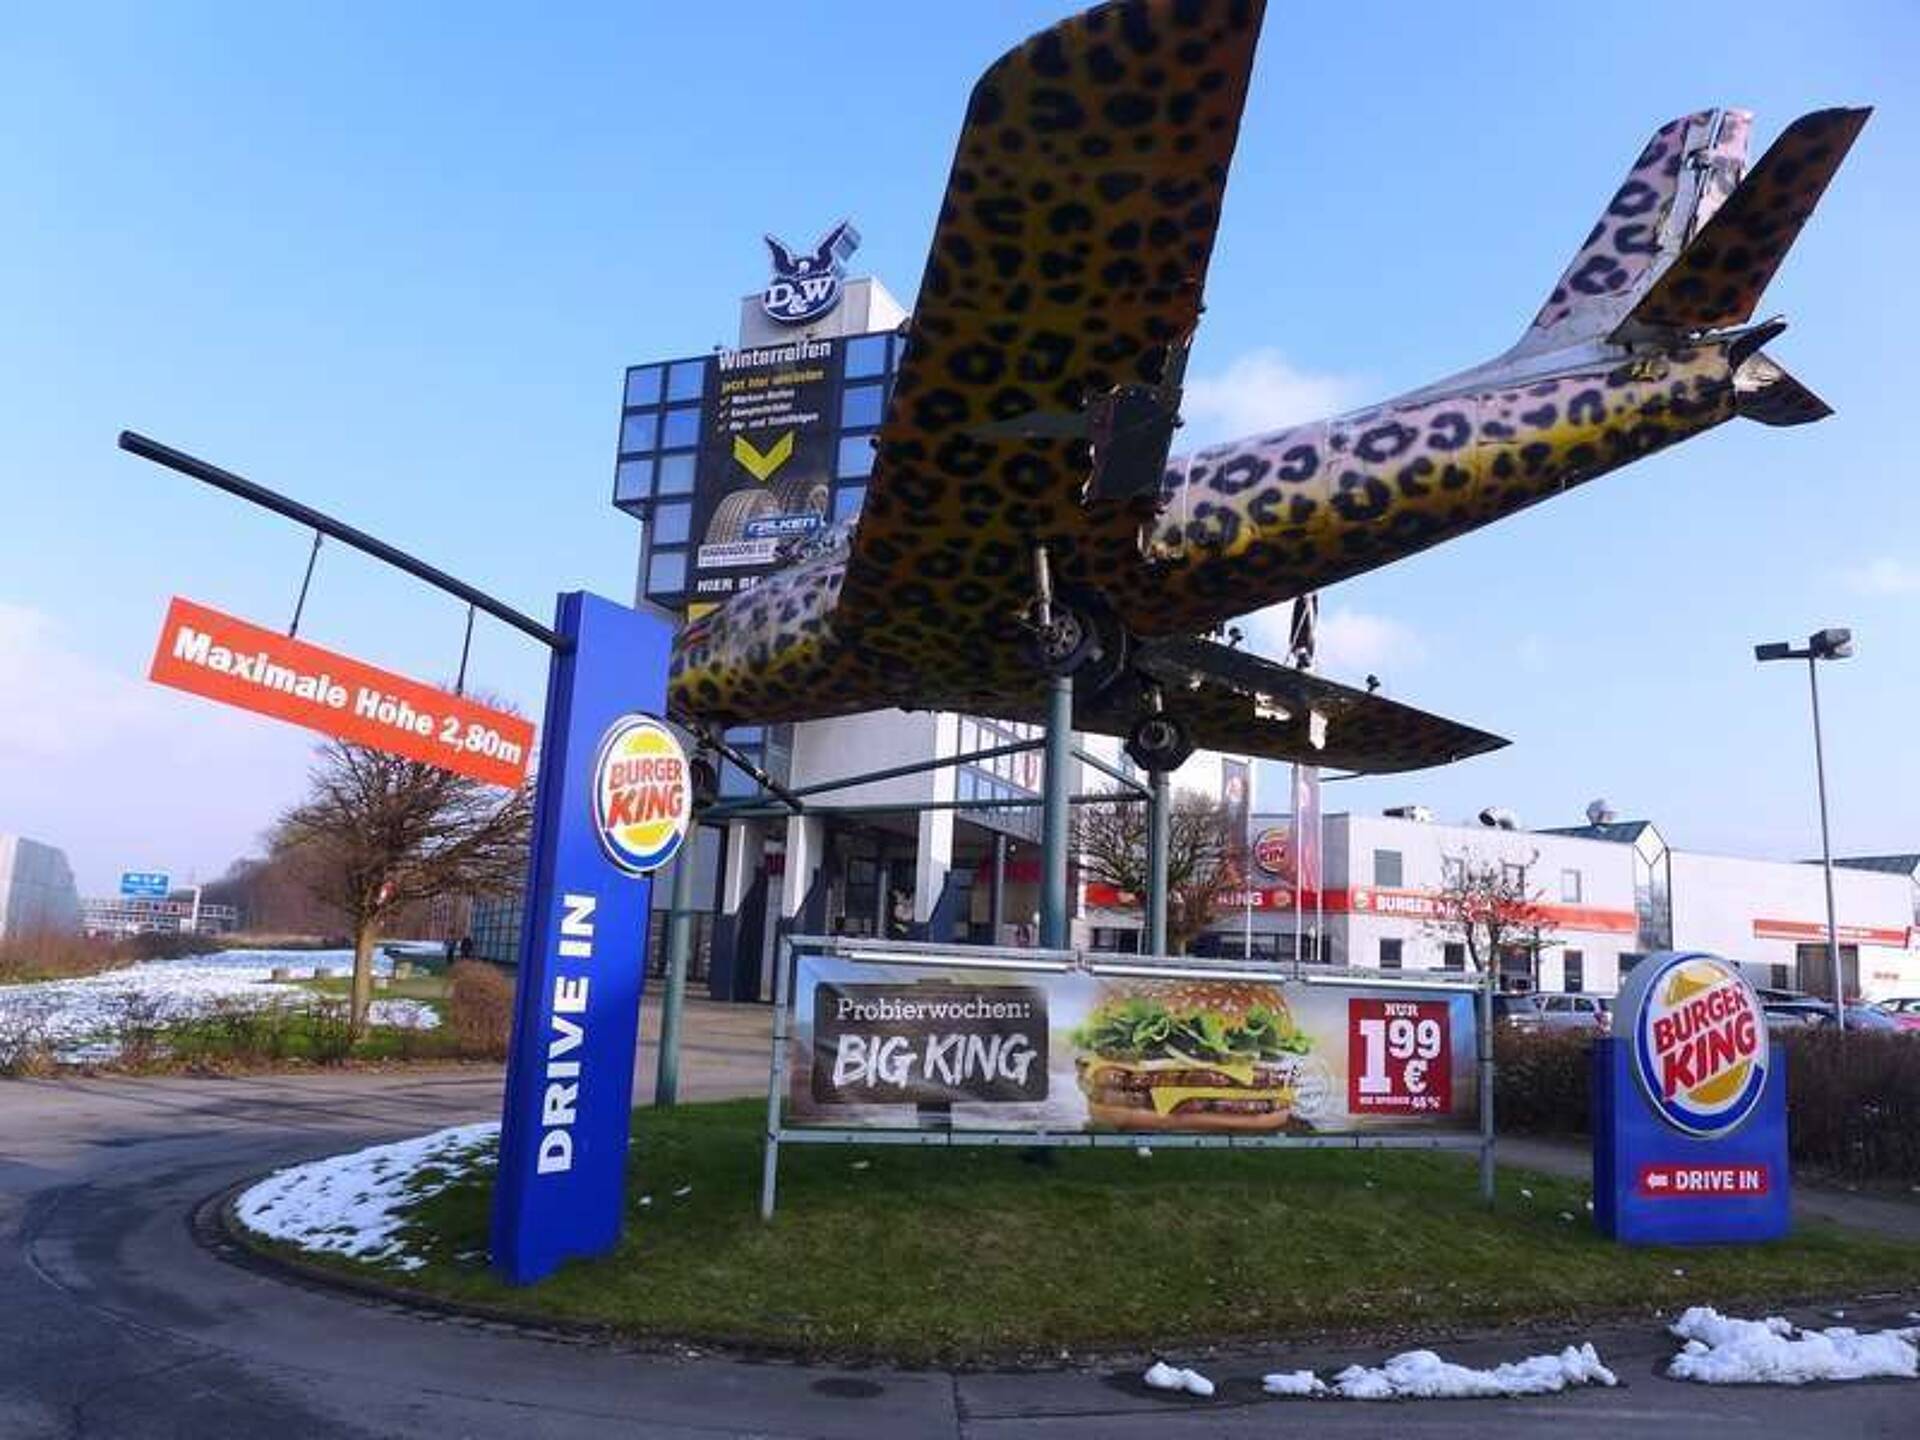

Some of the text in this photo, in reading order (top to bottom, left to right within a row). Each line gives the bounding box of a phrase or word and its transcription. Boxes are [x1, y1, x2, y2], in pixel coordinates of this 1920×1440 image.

[766, 278, 832, 315] D&W
[719, 340, 831, 370] Winterreifen
[172, 625, 523, 765] Maximale Höhe 2,80m
[609, 757, 683, 790] BURGER
[606, 784, 684, 829] KING
[1375, 892, 1434, 915] BURGER
[836, 997, 1032, 1021] Probierwochen:
[1384, 1003, 1419, 1016] NUR
[1653, 980, 1749, 1051] BURGER
[537, 894, 597, 1175] DRIVE IN
[832, 1033, 1038, 1088] BIG KING
[1661, 1012, 1758, 1100] KING
[1675, 1170, 1759, 1191] DRIVE IN
